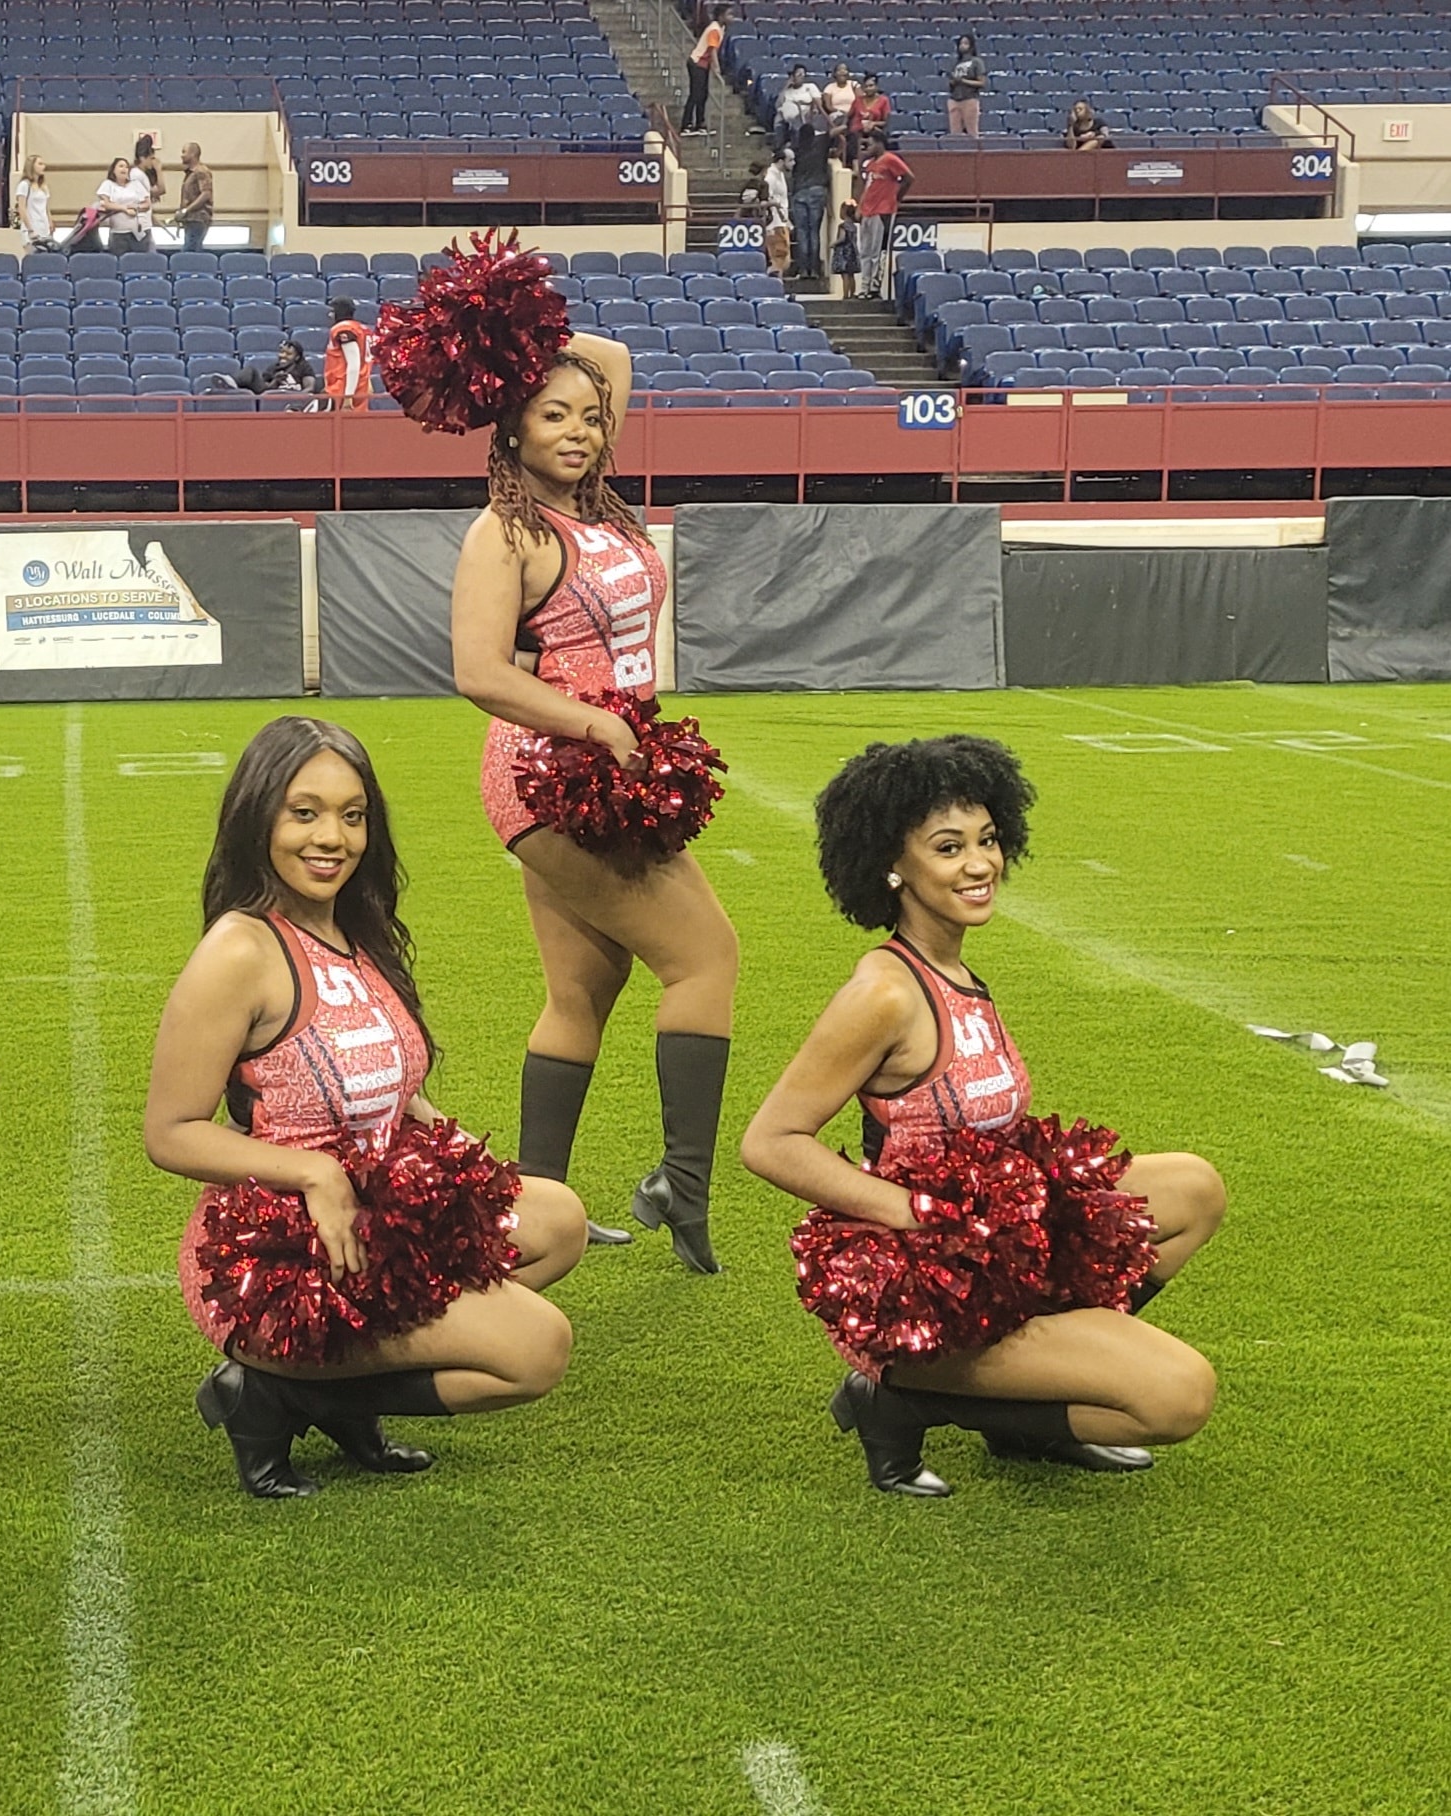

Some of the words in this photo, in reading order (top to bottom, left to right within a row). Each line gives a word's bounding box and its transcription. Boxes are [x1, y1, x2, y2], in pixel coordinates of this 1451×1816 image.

[1390, 123, 1409, 138] EXIT
[310, 161, 352, 183] 303
[619, 161, 661, 183] 303
[1291, 155, 1332, 177] 304
[719, 224, 764, 247] 203
[893, 224, 937, 247] 204
[900, 394, 956, 423] 103
[55, 560, 103, 580] Walt
[14, 598, 23, 609] 3
[25, 592, 98, 608] LOCATIONS
[101, 592, 119, 604] TO
[123, 592, 164, 603] SERVE
[572, 527, 654, 689] BULLS
[22, 612, 80, 626] HATTIESBURG
[92, 611, 135, 621] LUCEDALE
[312, 965, 403, 1130] ULLS
